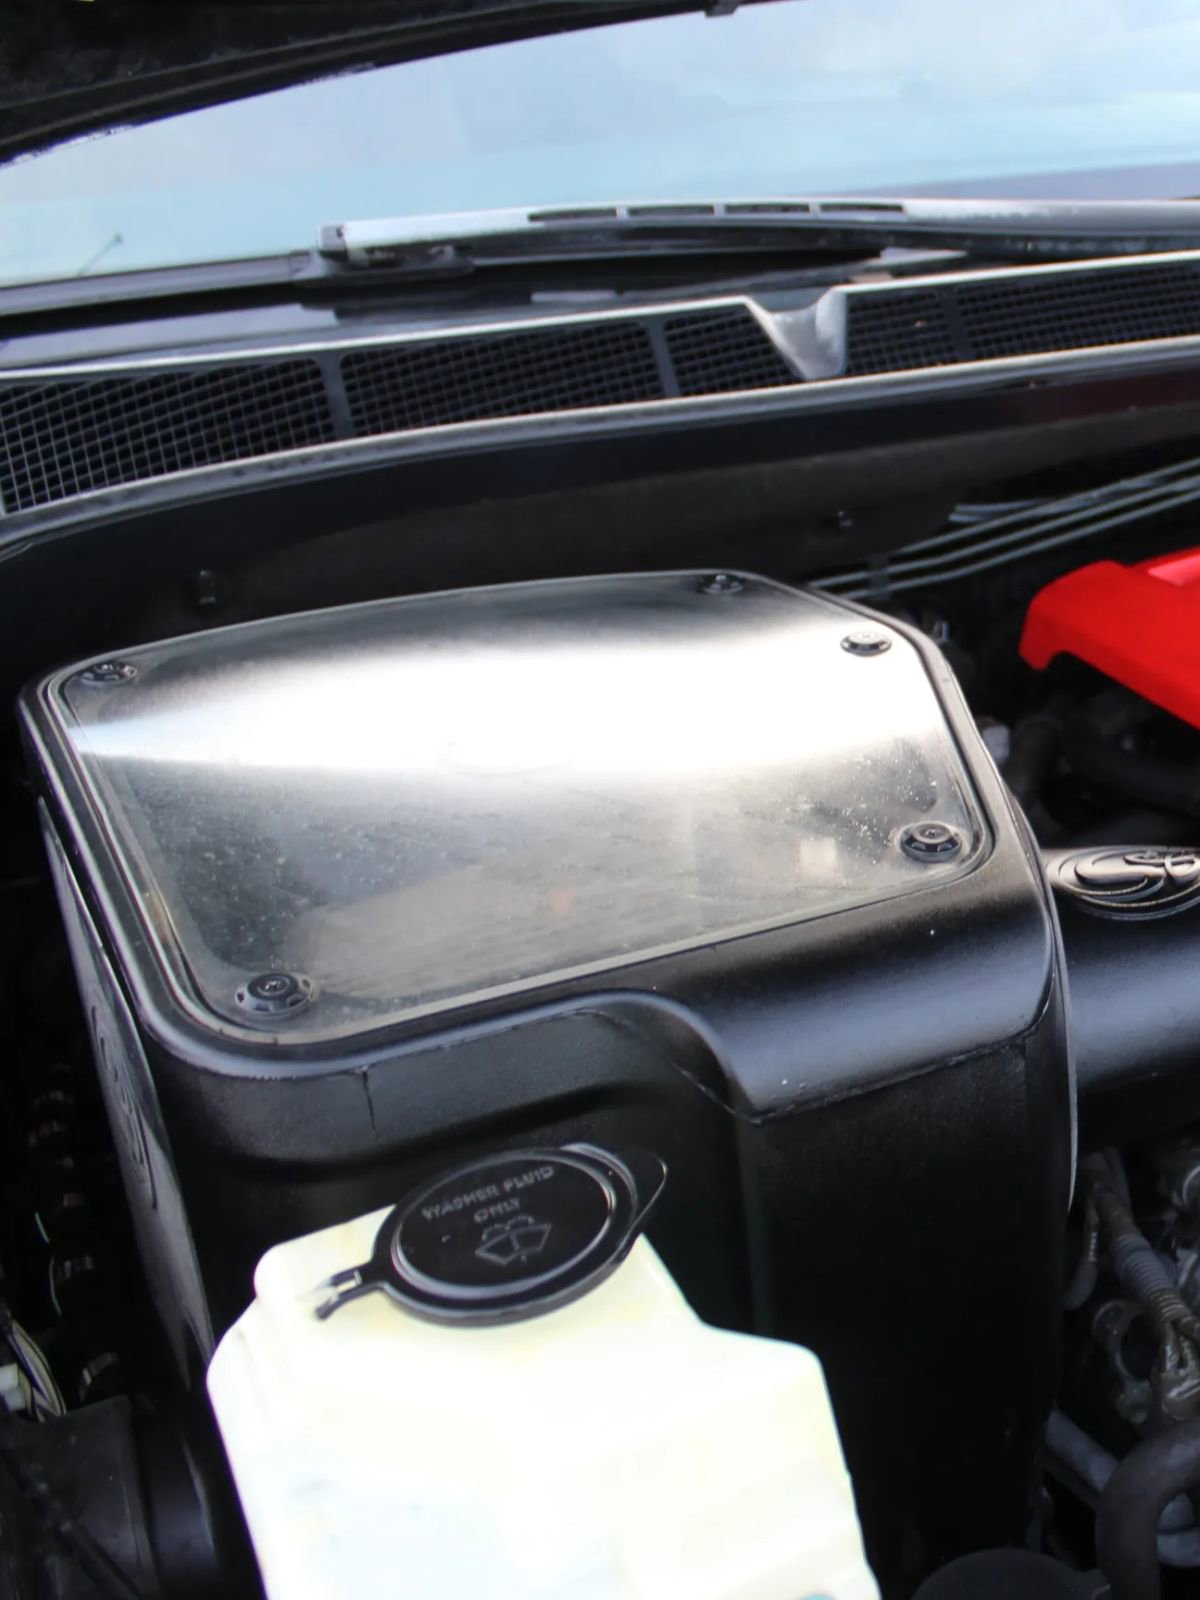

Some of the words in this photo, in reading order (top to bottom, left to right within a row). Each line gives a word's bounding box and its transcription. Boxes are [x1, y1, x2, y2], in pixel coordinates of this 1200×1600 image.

[422, 1184, 499, 1221] WASHER
[502, 1166, 555, 1193] FLUID
[473, 1197, 521, 1224] ONLY
